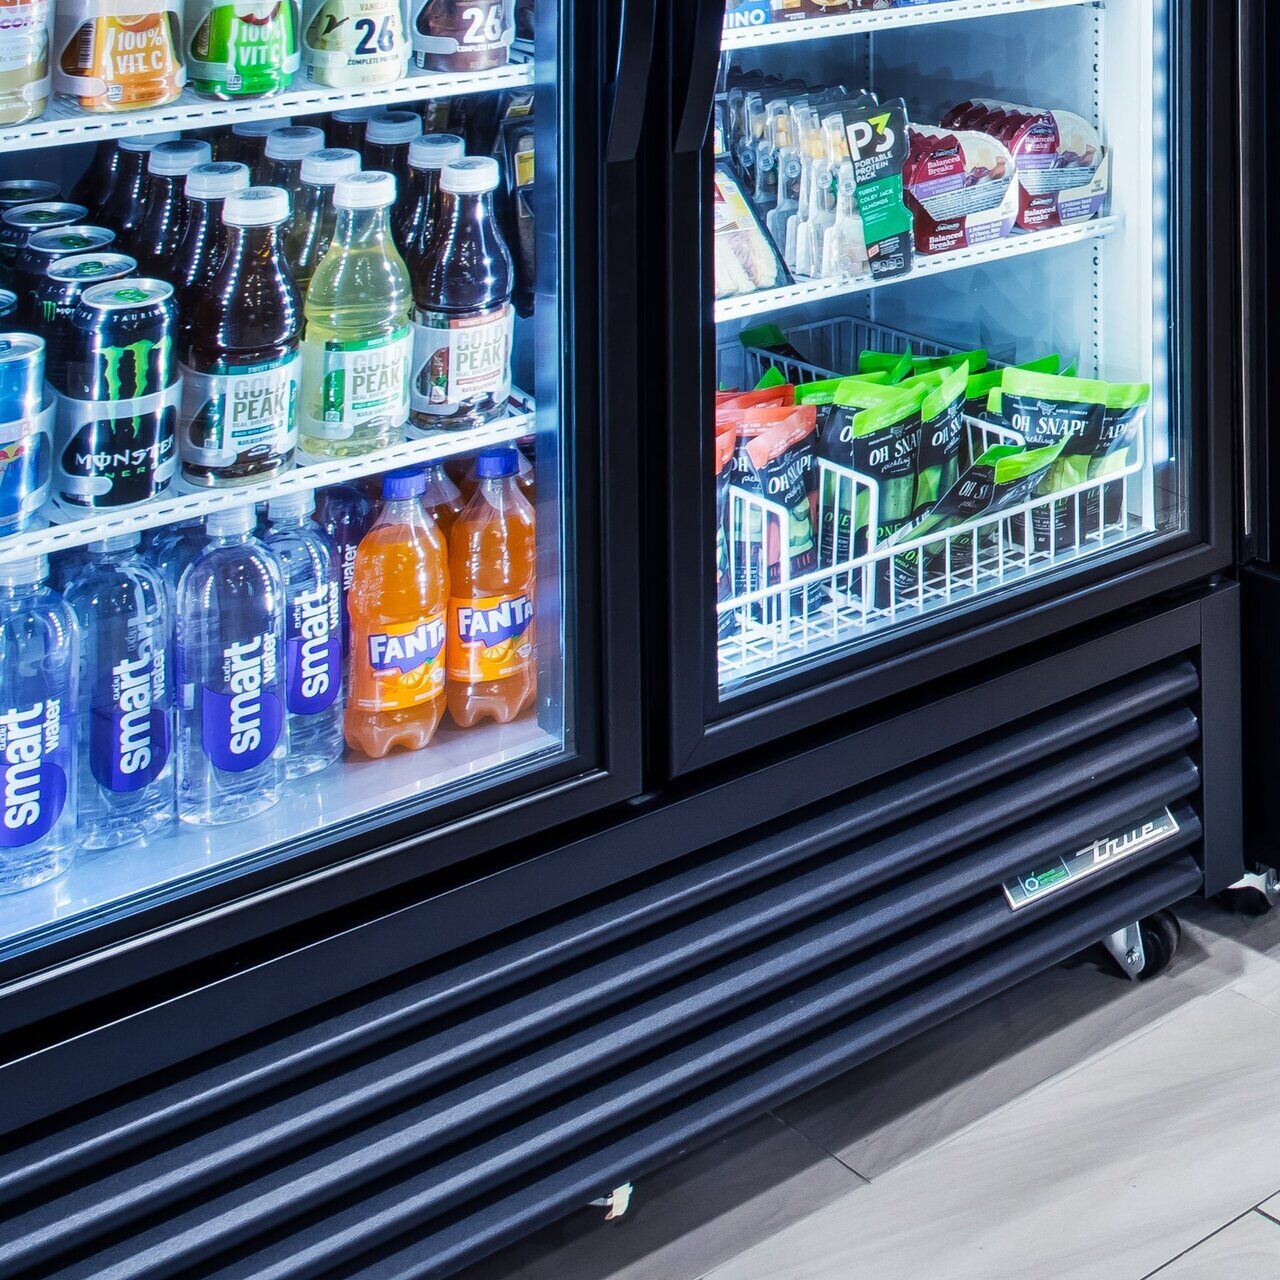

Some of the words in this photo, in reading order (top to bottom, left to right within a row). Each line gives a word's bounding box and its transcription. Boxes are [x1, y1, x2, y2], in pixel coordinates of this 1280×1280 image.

[354, 15, 395, 56] 26
[463, 5, 501, 45] 26
[117, 27, 163, 51] 100%
[1024, 136, 1055, 146] Balanced
[854, 150, 894, 169] PORTABLE
[856, 160, 889, 176] PROTEIN
[927, 155, 962, 170] Balanced
[856, 171, 877, 184] PACK
[928, 165, 954, 176] Breaks
[1024, 205, 1057, 218] Balanced
[1024, 213, 1048, 224] Breaks
[928, 230, 964, 245] Balanced
[929, 239, 957, 251] Breaks
[456, 343, 503, 372] PEAK
[352, 368, 403, 396] PEAK
[234, 392, 286, 423] PEAK
[1011, 413, 1030, 432] OH
[1038, 417, 1090, 437] SNAP!
[868, 448, 890, 467] OH
[458, 594, 534, 638] FANTA
[301, 584, 330, 700] smart
[261, 631, 277, 684] water
[229, 635, 263, 756] smart
